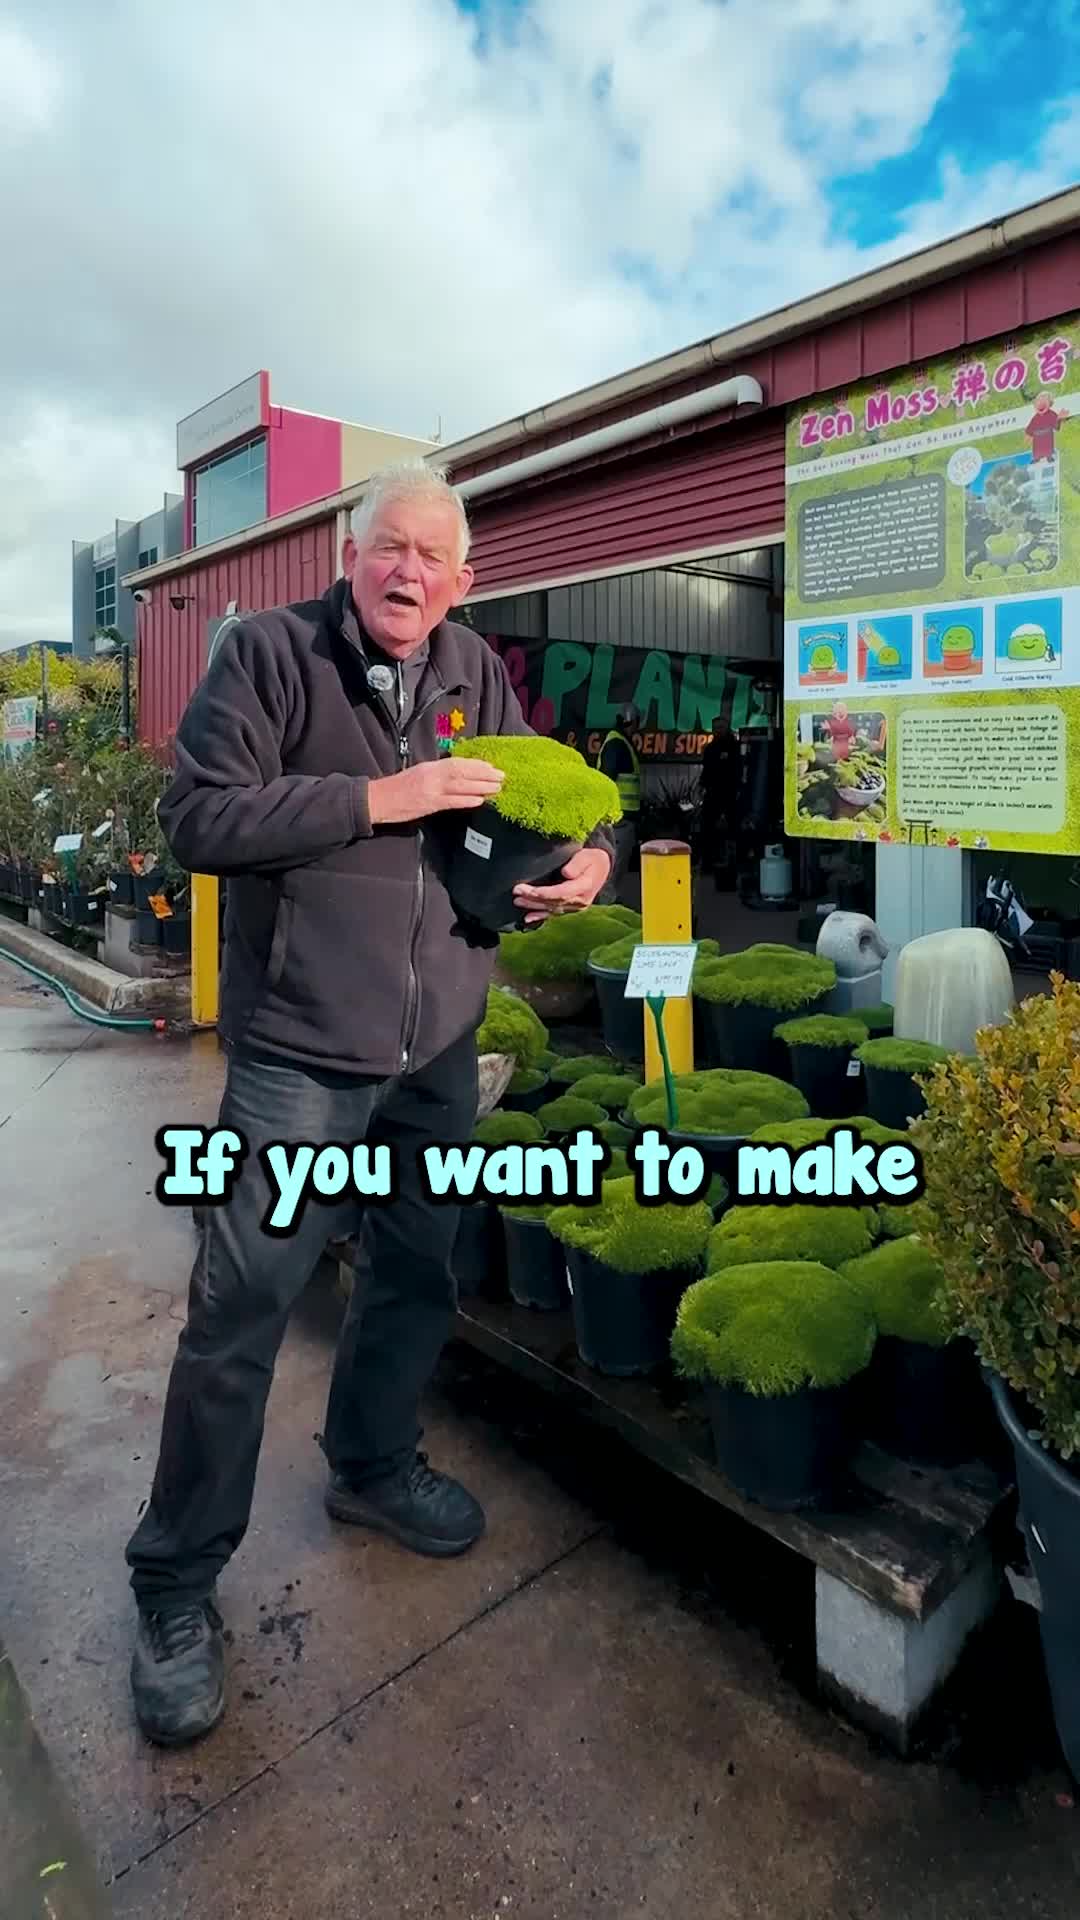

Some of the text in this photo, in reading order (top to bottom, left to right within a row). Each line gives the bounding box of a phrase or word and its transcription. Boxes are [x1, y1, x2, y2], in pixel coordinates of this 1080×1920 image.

[953, 338, 1070, 405] 禅の苔
[800, 386, 939, 448] Zen Moss
[883, 444, 903, 456] That
[967, 416, 1018, 434] Anywhere
[587, 731, 668, 755] GDEN
